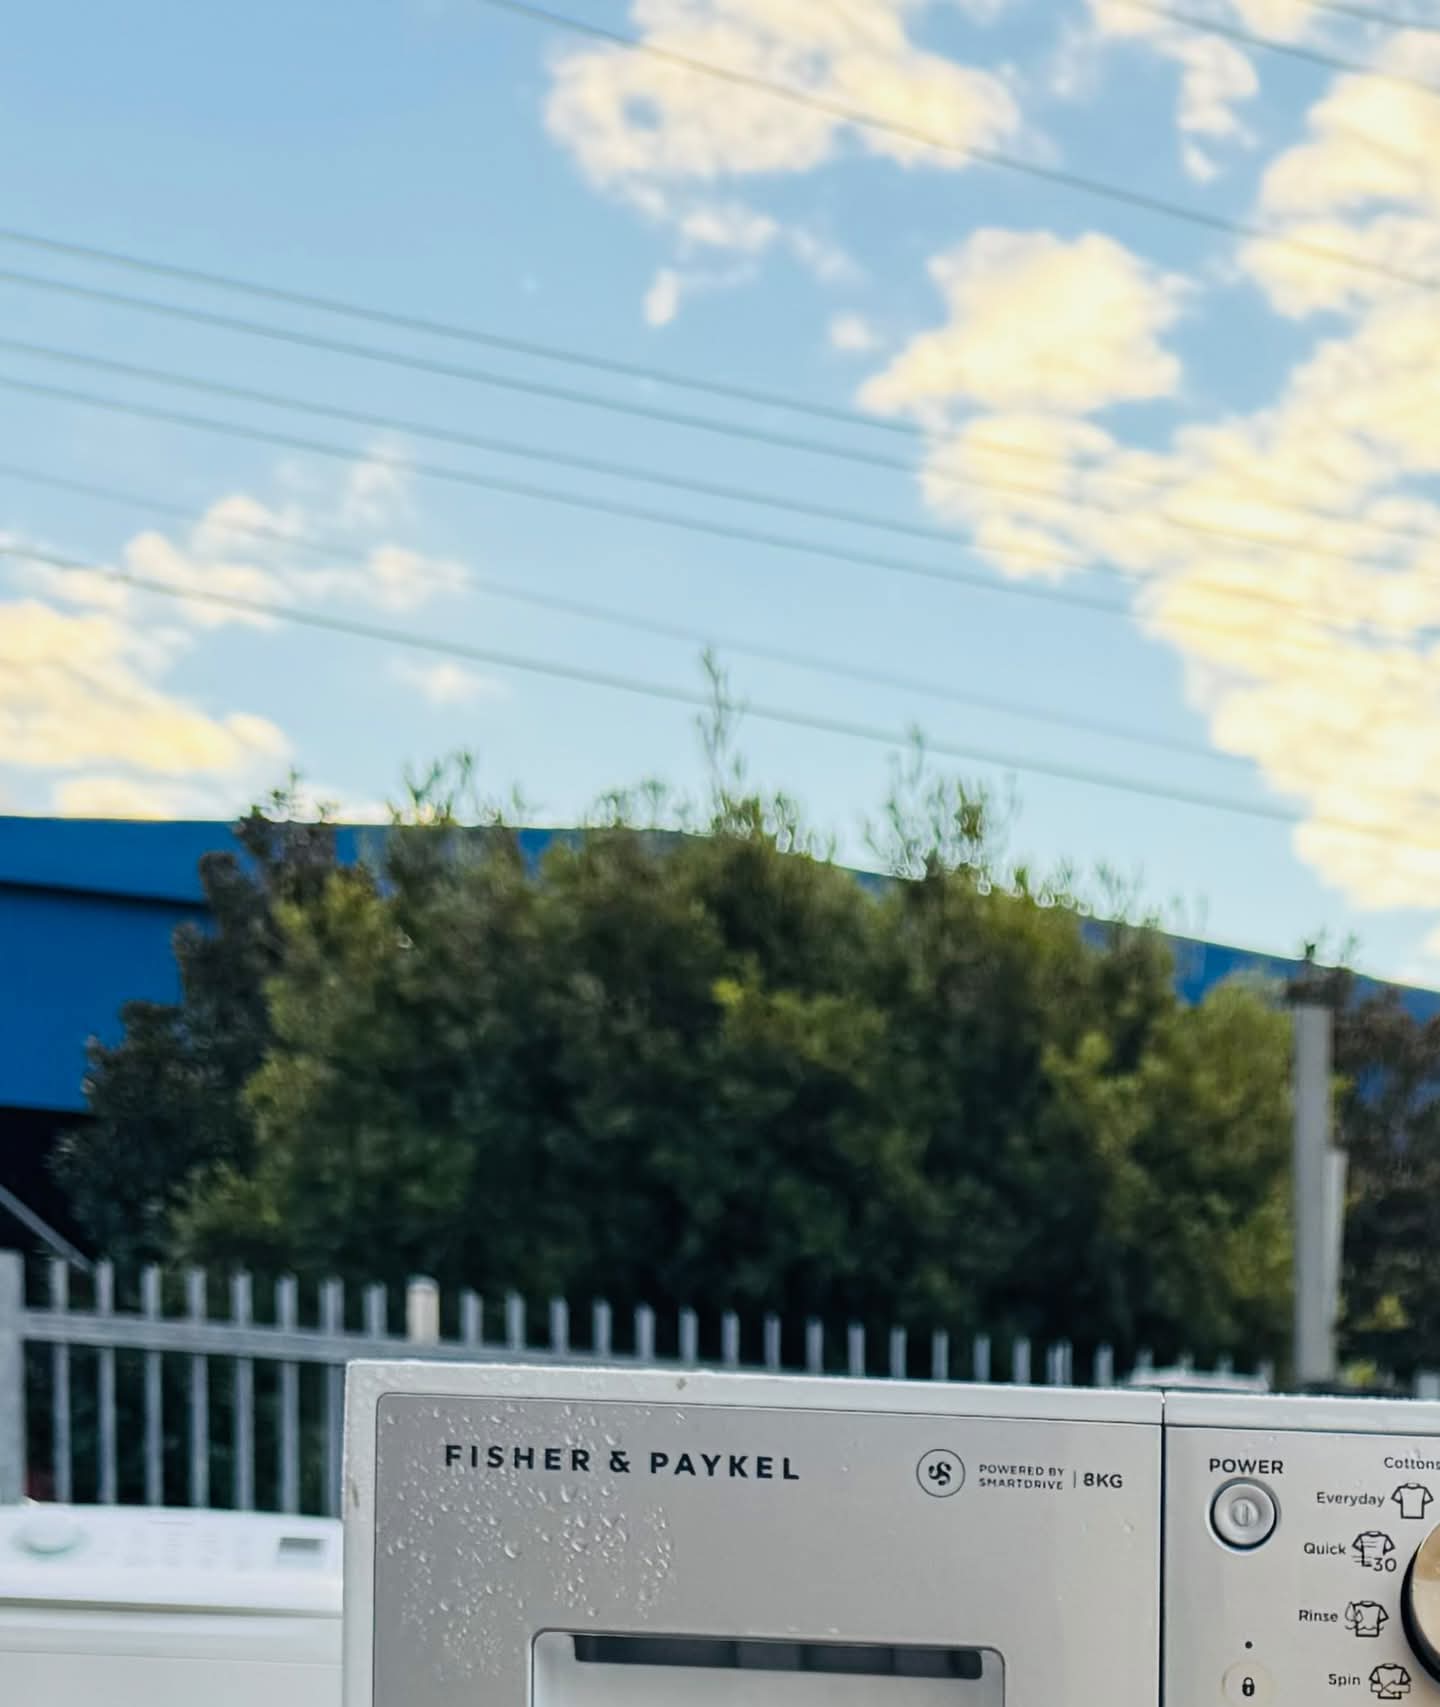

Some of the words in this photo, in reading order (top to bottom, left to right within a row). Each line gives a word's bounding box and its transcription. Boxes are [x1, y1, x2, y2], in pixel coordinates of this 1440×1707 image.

[445, 1444, 590, 1472] FISHER
[609, 1450, 631, 1473] &
[650, 1451, 800, 1480] PAYKEL
[1208, 1458, 1284, 1475] POWER
[979, 1464, 1044, 1476] POWERED
[1049, 1466, 1065, 1477] BY
[978, 1477, 1064, 1490] SMARTDRIVE
[1082, 1472, 1124, 1489] 8KG
[1316, 1491, 1386, 1507] Everyday
[1304, 1542, 1346, 1556] Quick
[1373, 1558, 1397, 1572] 30
[1298, 1609, 1339, 1622] Rinse
[1328, 1673, 1361, 1687] Spin
